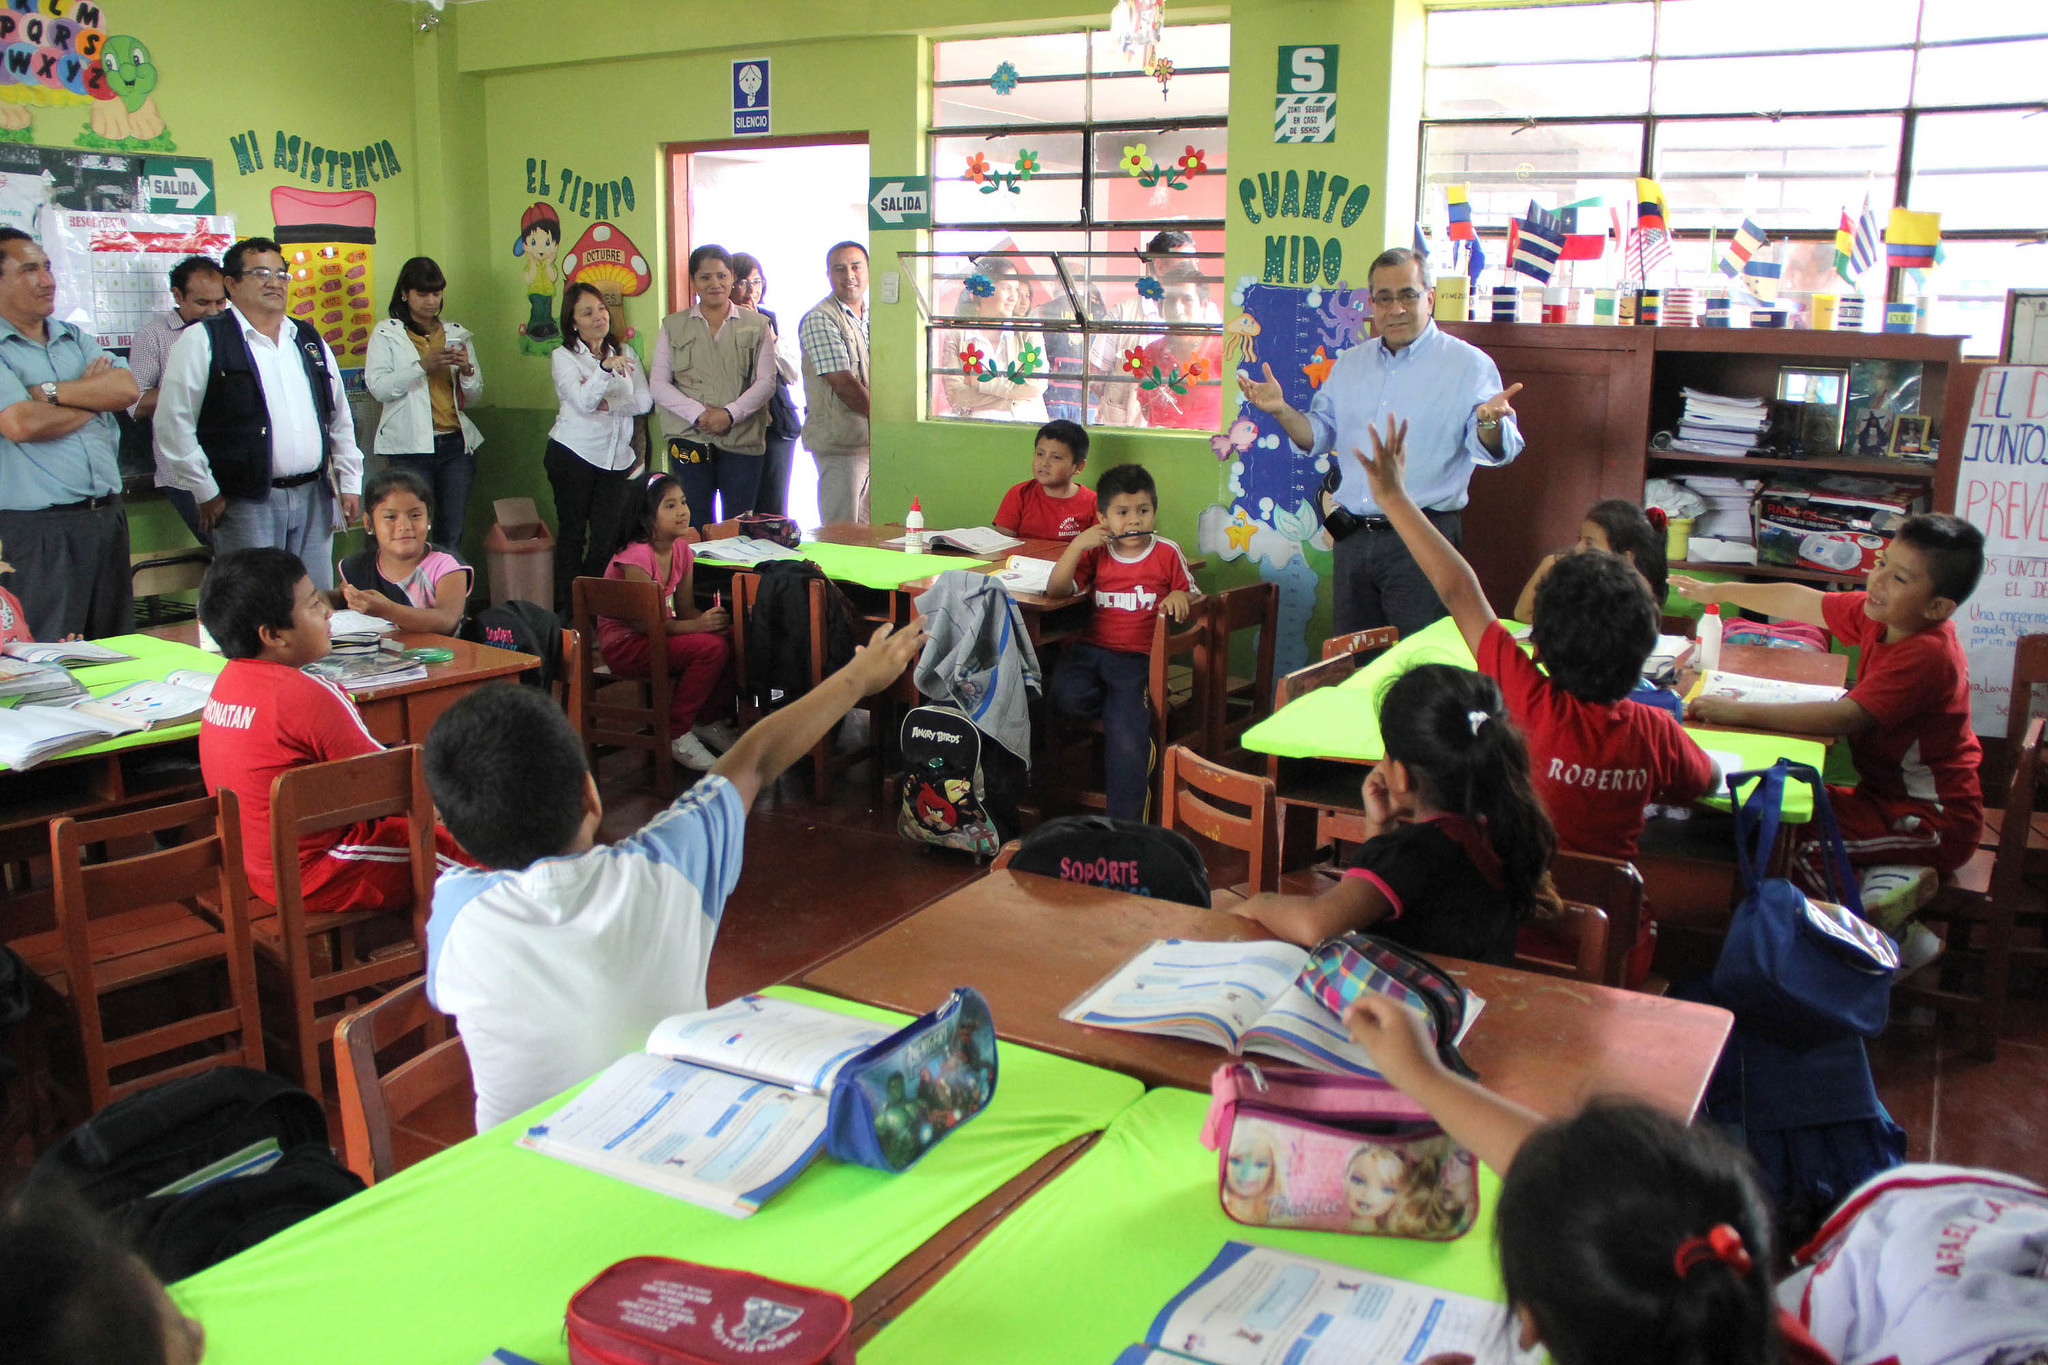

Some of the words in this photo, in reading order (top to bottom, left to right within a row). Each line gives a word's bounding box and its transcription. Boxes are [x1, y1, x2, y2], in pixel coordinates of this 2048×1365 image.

[76, 2, 99, 28] M
[27, 19, 43, 44] Q
[54, 24, 71, 50] R
[84, 34, 99, 55] S
[8, 48, 32, 75] W
[37, 53, 56, 78] X
[67, 60, 81, 83] Y
[1291, 47, 1325, 92] S
[735, 115, 767, 128] SILENCIO
[1289, 127, 1297, 135] DE
[1300, 126, 1320, 134] SISMOS
[1293, 116, 1301, 124] EN
[1303, 116, 1317, 124] CASO
[274, 130, 402, 189] ASISTENCIA
[154, 179, 198, 196] SALIDA
[526, 158, 550, 196] EL
[558, 168, 635, 220] TIEMPO
[1239, 169, 1370, 228] CUANTO
[880, 196, 921, 211] SALIDA
[586, 249, 621, 262] OCTUBRE
[1263, 235, 1342, 285] MIDO
[1979, 371, 2012, 418] EL
[1965, 480, 2048, 541] PREVE
[1096, 590, 1137, 611] PERU
[2005, 581, 2021, 597] EL
[2031, 581, 2048, 598] DE
[1970, 603, 1995, 621] Una
[1972, 625, 2007, 638] aguda
[203, 697, 257, 730] HONATAN
[911, 726, 936, 741] ANGRY
[936, 731, 960, 744] BIRDS
[1548, 757, 1648, 791] ROBERTO
